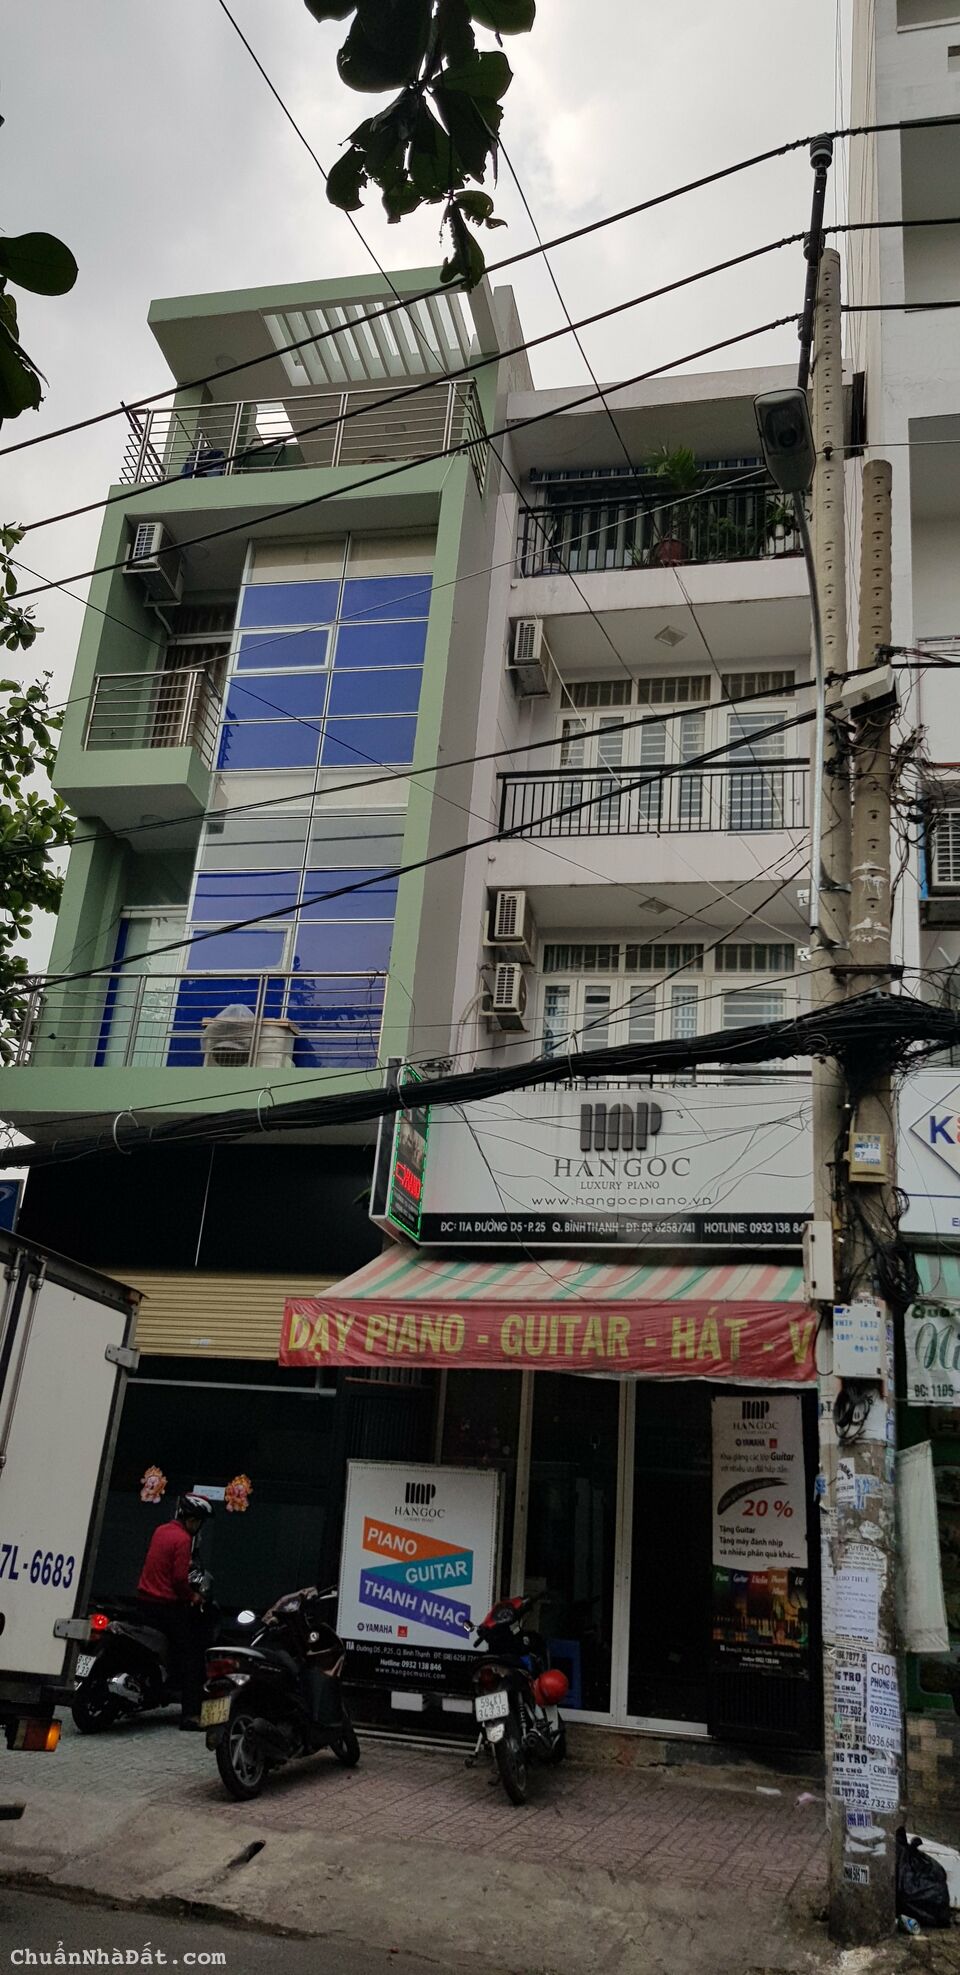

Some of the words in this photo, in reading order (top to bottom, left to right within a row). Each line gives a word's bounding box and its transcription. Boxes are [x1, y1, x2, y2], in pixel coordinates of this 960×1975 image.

[580, 1181, 623, 1190] LUXURY
[627, 1181, 660, 1190] PIANO
[531, 1196, 712, 1207] www.hangocpiano.vn
[459, 1222, 472, 1232] 11A
[474, 1218, 507, 1232] ĐƯỜNG
[704, 1222, 748, 1233] HOTLINE:
[750, 1222, 773, 1233] 0932
[775, 1222, 791, 1233] 138
[288, 1313, 355, 1360] DẠY
[365, 1313, 465, 1354] PIANO
[501, 1314, 631, 1358] GUITAR
[671, 1306, 748, 1361] HÁT
[770, 1451, 794, 1461] Guitar
[742, 1500, 768, 1517] 20
[773, 1500, 793, 1517] %
[735, 1526, 755, 1534] Guitar
[367, 1527, 418, 1555] PIANO
[405, 1560, 468, 1584] GUITAR
[364, 1580, 417, 1610] THANH
[421, 1601, 467, 1628] NHẠC
[365, 1623, 393, 1635] YAMAHA
